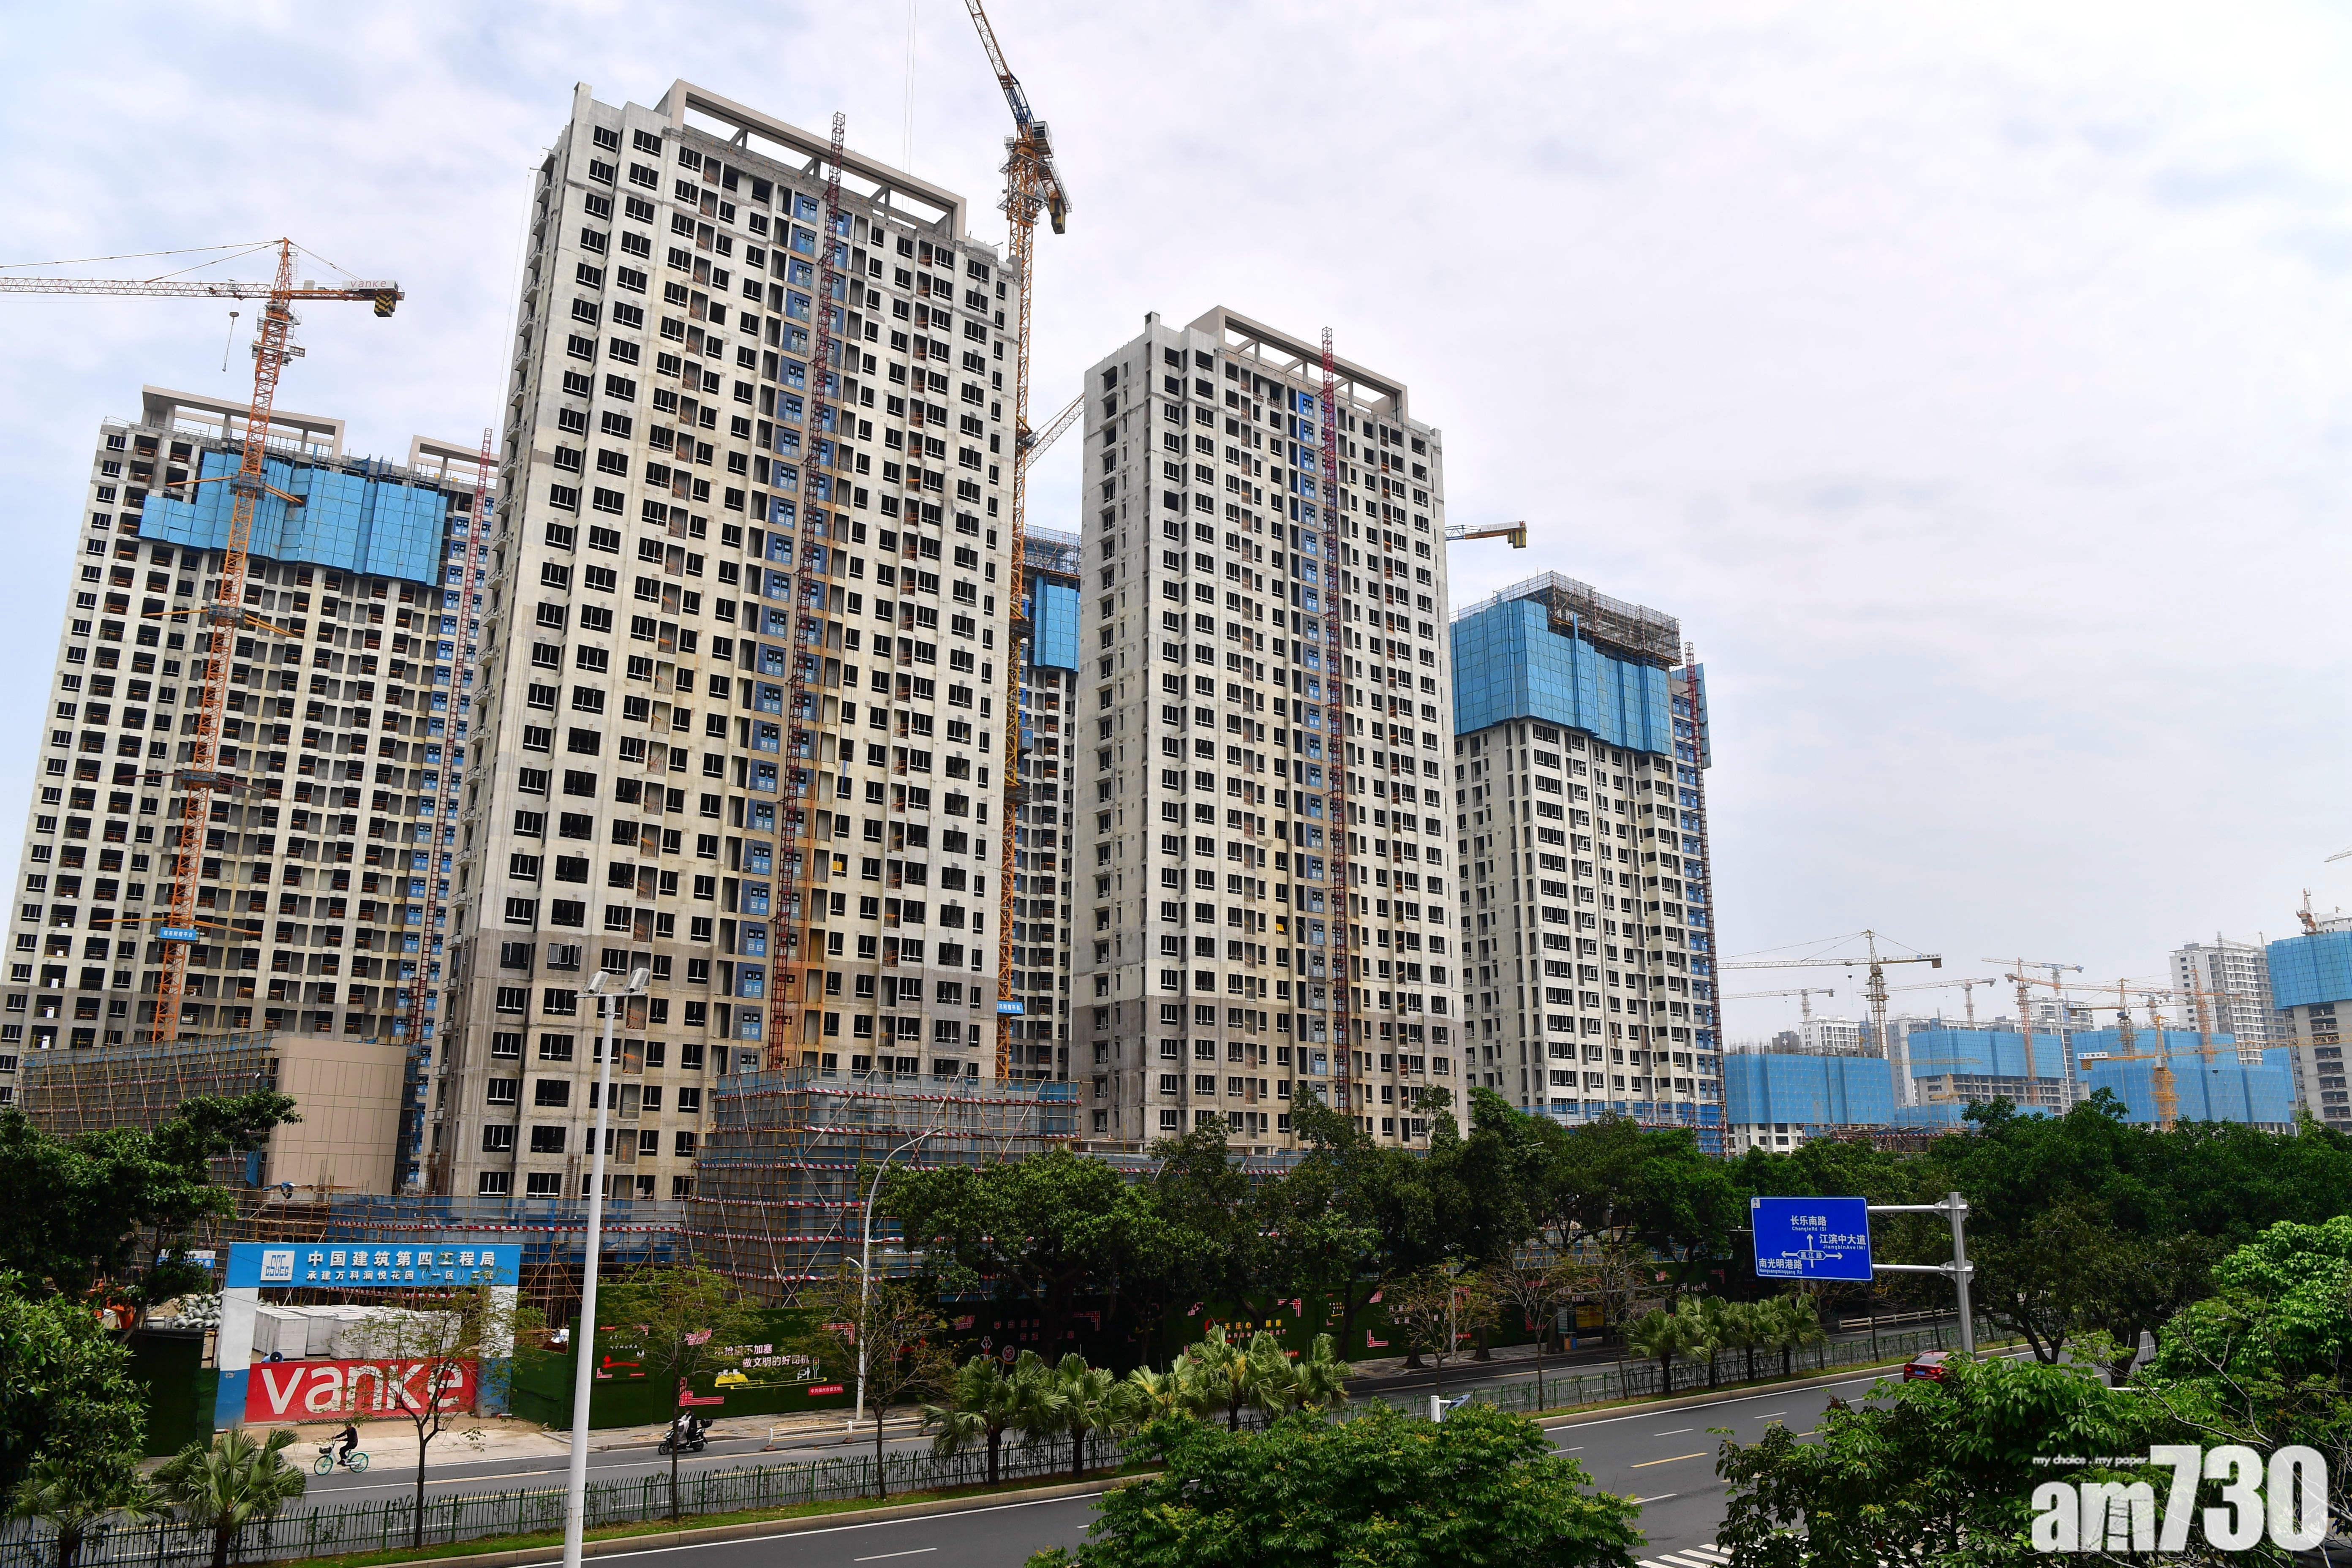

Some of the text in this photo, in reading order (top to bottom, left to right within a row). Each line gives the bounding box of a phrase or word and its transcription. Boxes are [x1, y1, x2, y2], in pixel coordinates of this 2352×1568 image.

[1791, 1215, 1827, 1226] 长乐南路
[1819, 1233, 1866, 1245] 江滨中大道
[308, 1250, 495, 1266] 中国建筑第四工程局
[1759, 1258, 1802, 1269] 南光明港路
[743, 1354, 809, 1368] 做文明的好司机
[261, 1362, 463, 1415] vanke
